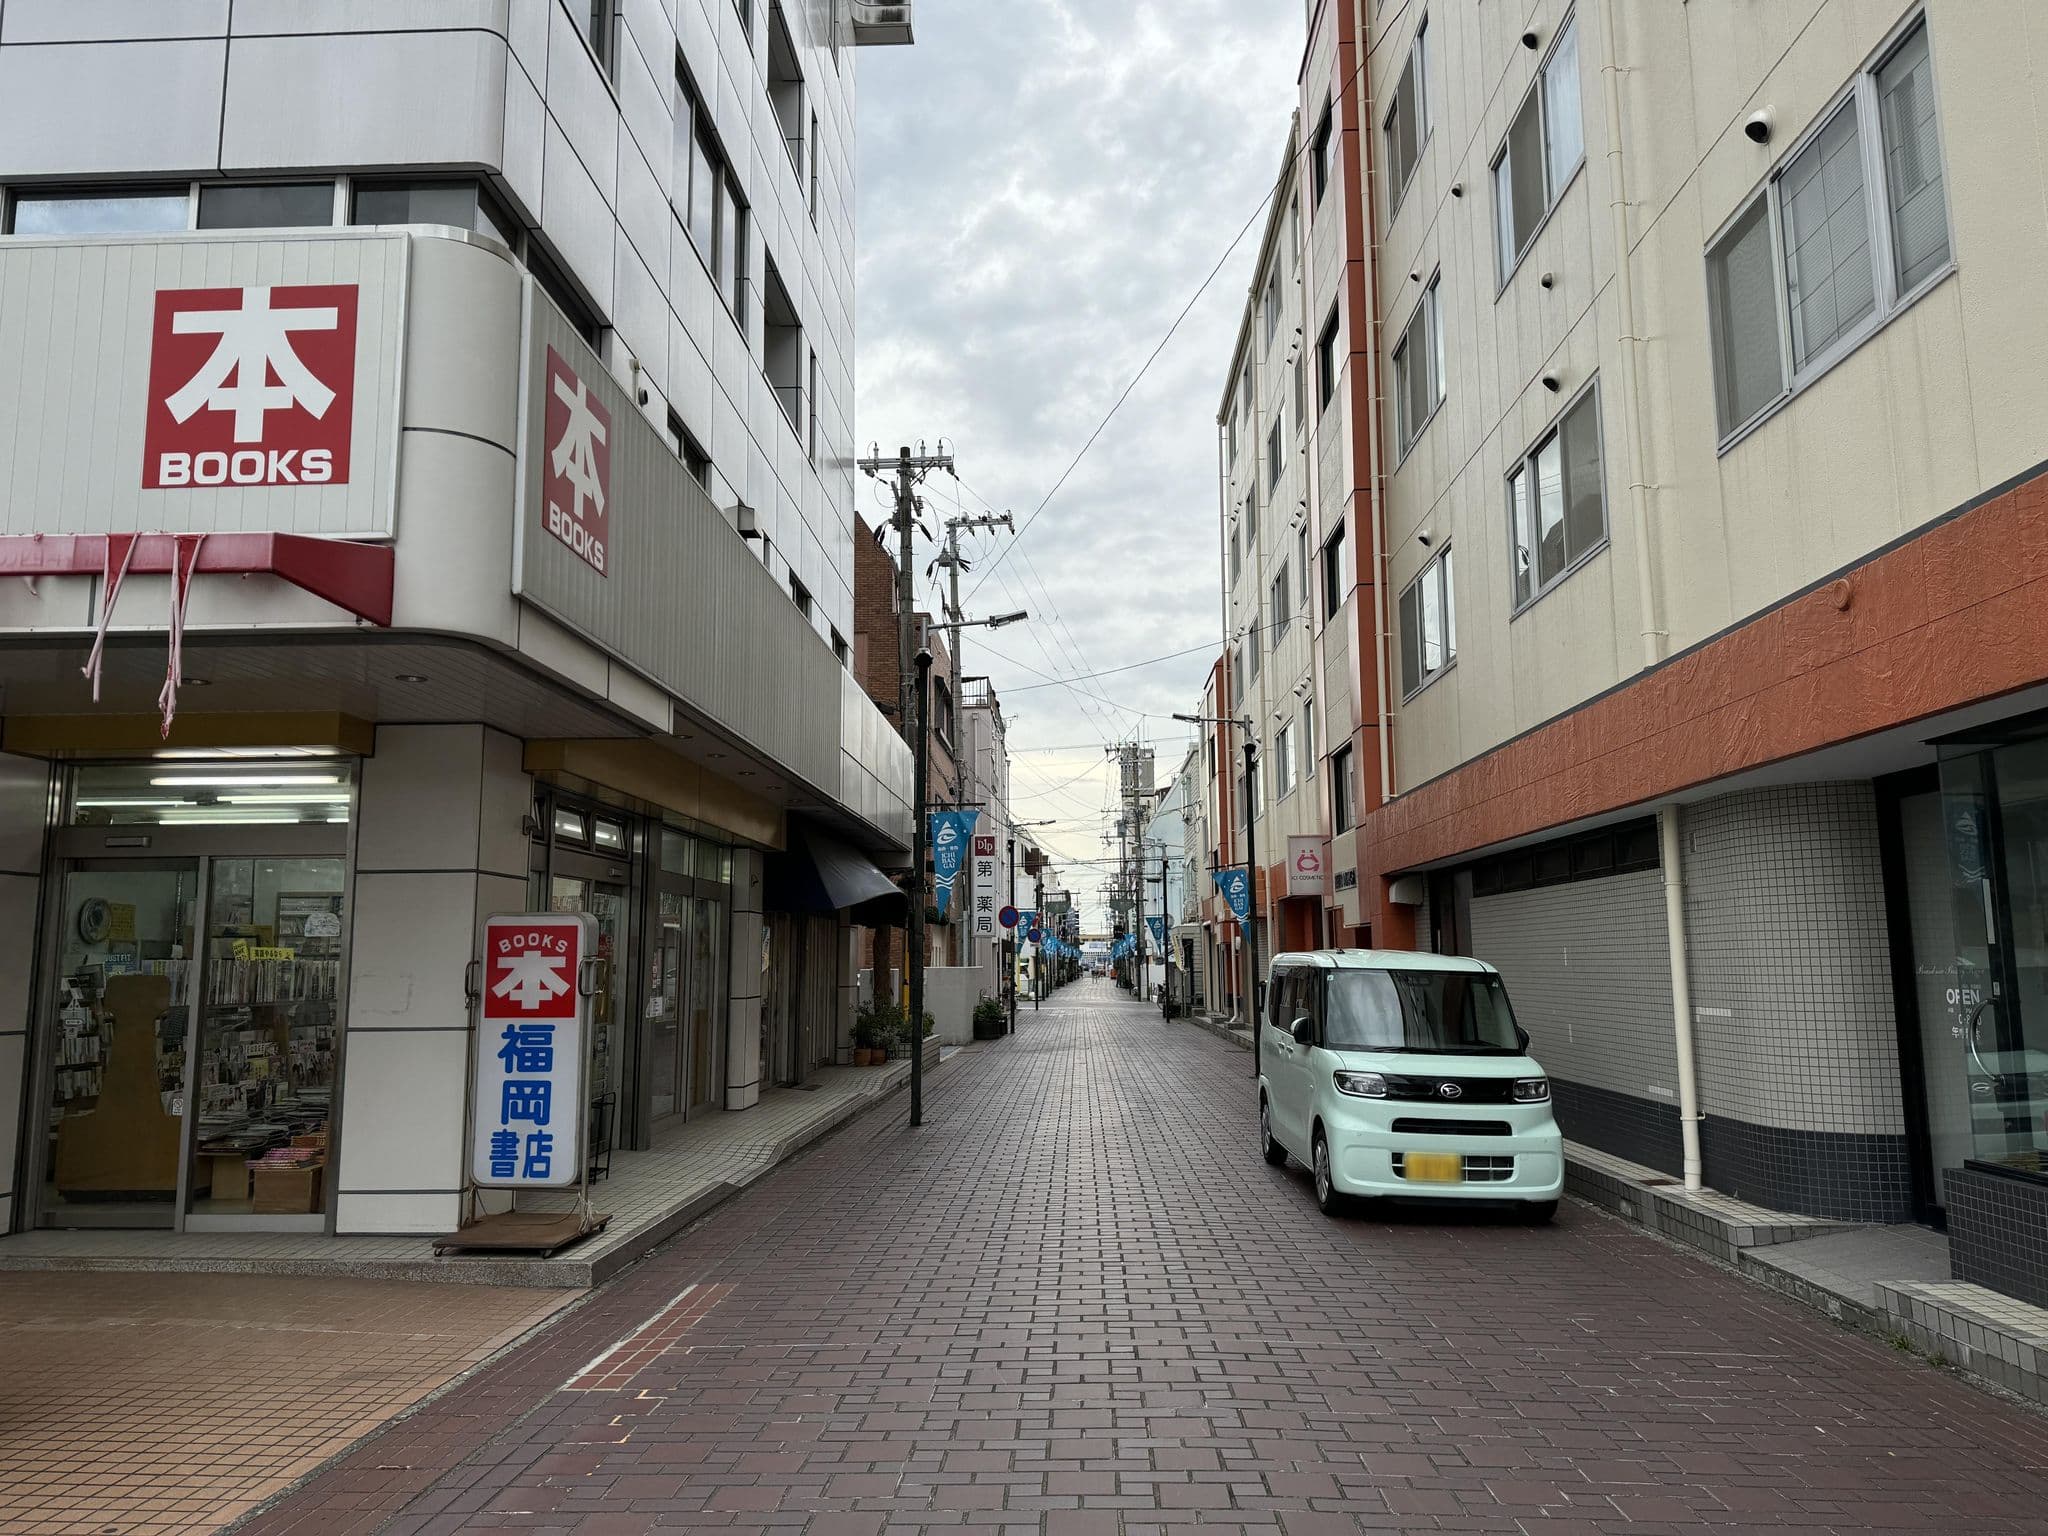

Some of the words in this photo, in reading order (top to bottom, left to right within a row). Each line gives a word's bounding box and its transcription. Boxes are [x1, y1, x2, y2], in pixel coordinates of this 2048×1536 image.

[164, 286, 337, 443] 本
[158, 448, 333, 486] BOOKS
[551, 374, 606, 519] 本
[548, 499, 605, 572] BOOKS
[976, 860, 994, 933] 第一薬局
[499, 932, 568, 953] BOOKS
[490, 950, 572, 1010] 本
[1946, 988, 1980, 1005] OPEN
